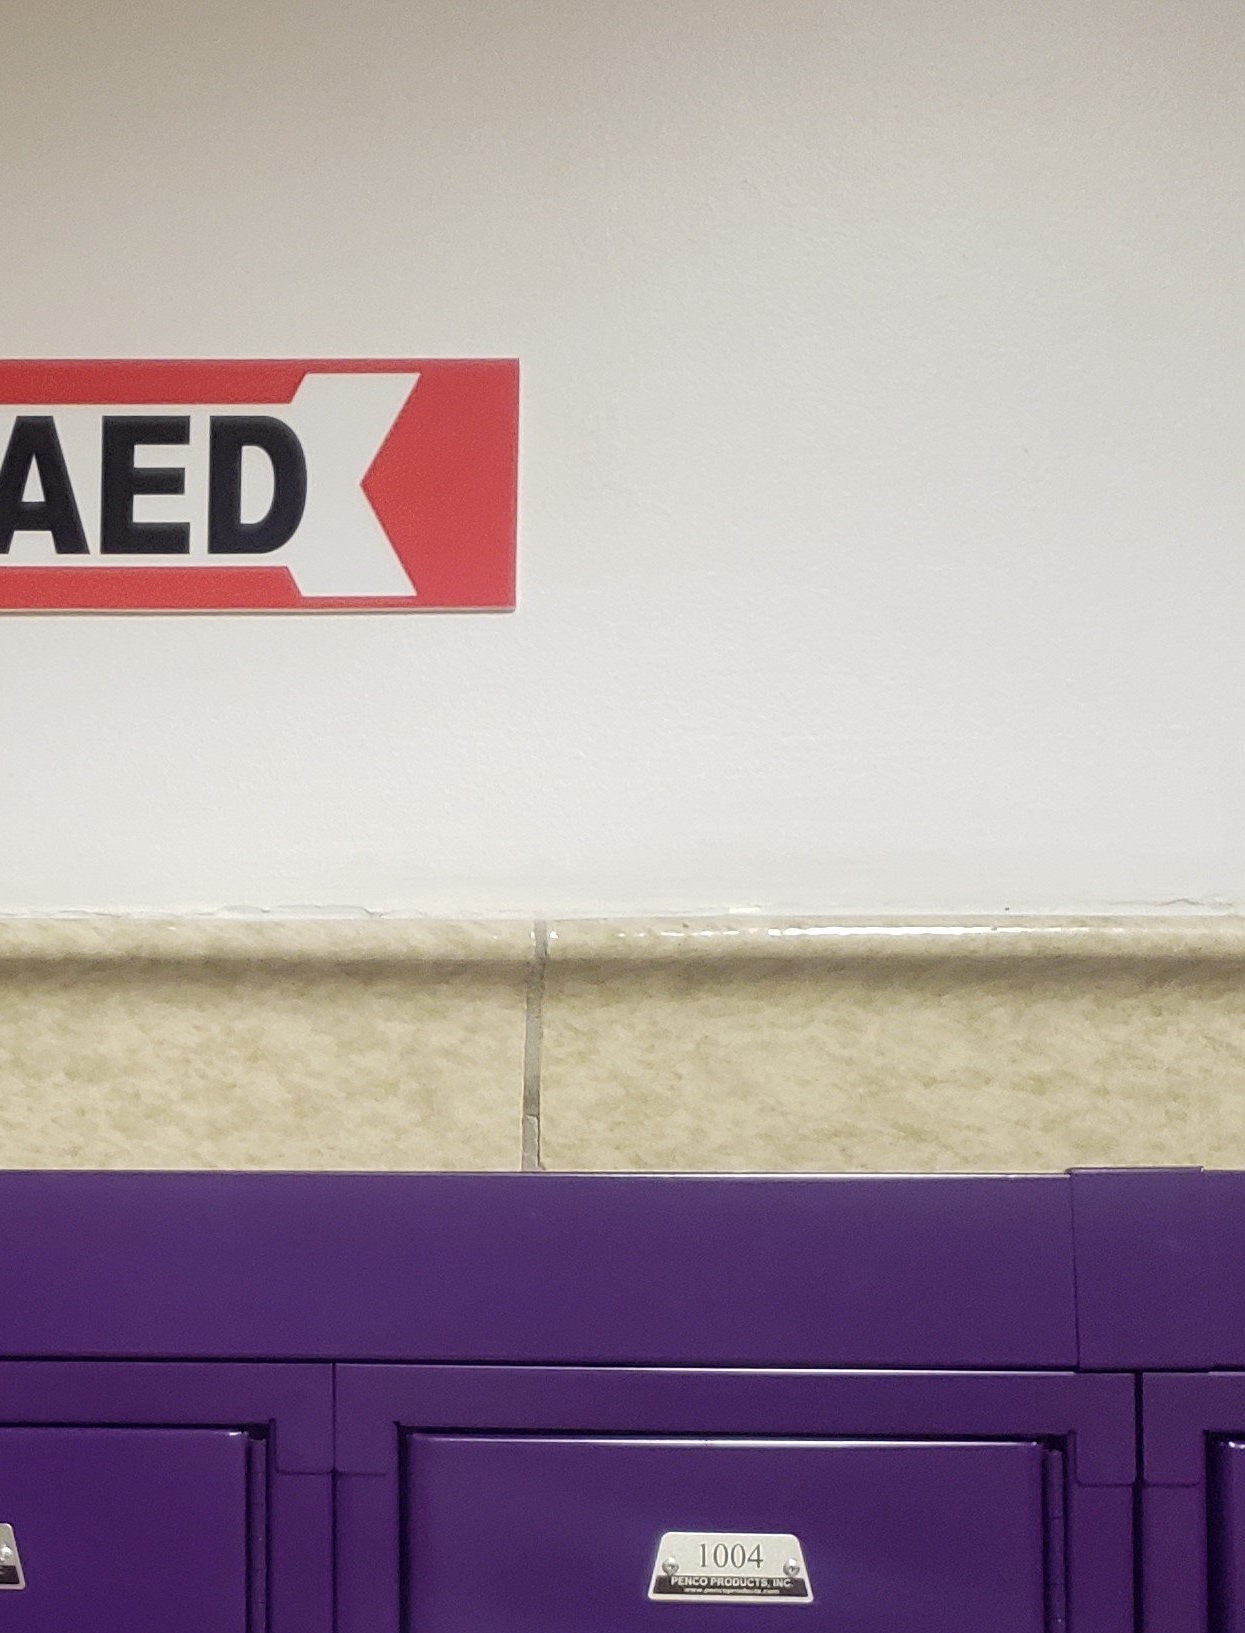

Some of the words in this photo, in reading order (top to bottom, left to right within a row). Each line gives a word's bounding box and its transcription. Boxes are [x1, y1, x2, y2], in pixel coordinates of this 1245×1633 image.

[698, 1543, 764, 1569] 1004
[671, 1577, 708, 1586] PENCO
[710, 1577, 771, 1588] PRODUCTS,
[773, 1579, 794, 1588] INC.
